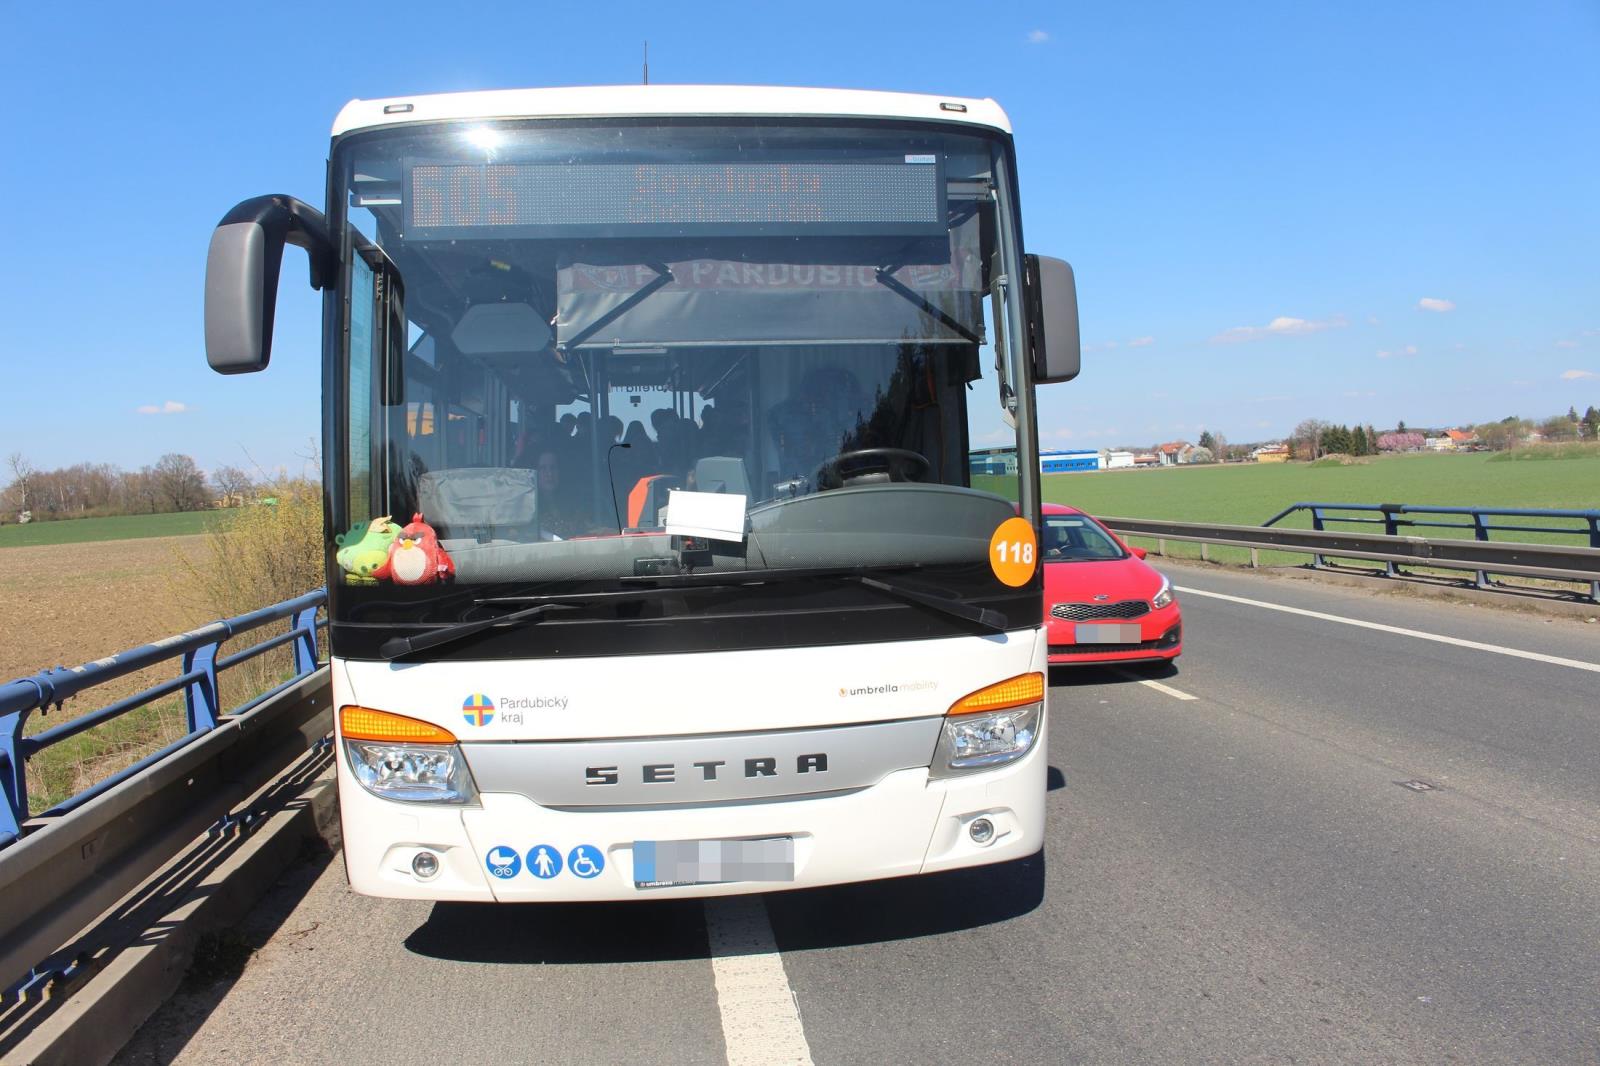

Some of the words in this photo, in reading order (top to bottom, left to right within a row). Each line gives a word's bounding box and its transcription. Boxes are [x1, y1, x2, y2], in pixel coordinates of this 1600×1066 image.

[412, 165, 519, 227] 605
[995, 540, 1033, 564] 118
[849, 683, 899, 696] umbrella
[500, 696, 569, 711] Pardubický
[501, 711, 524, 726] kraj
[586, 753, 828, 785] SETRA
